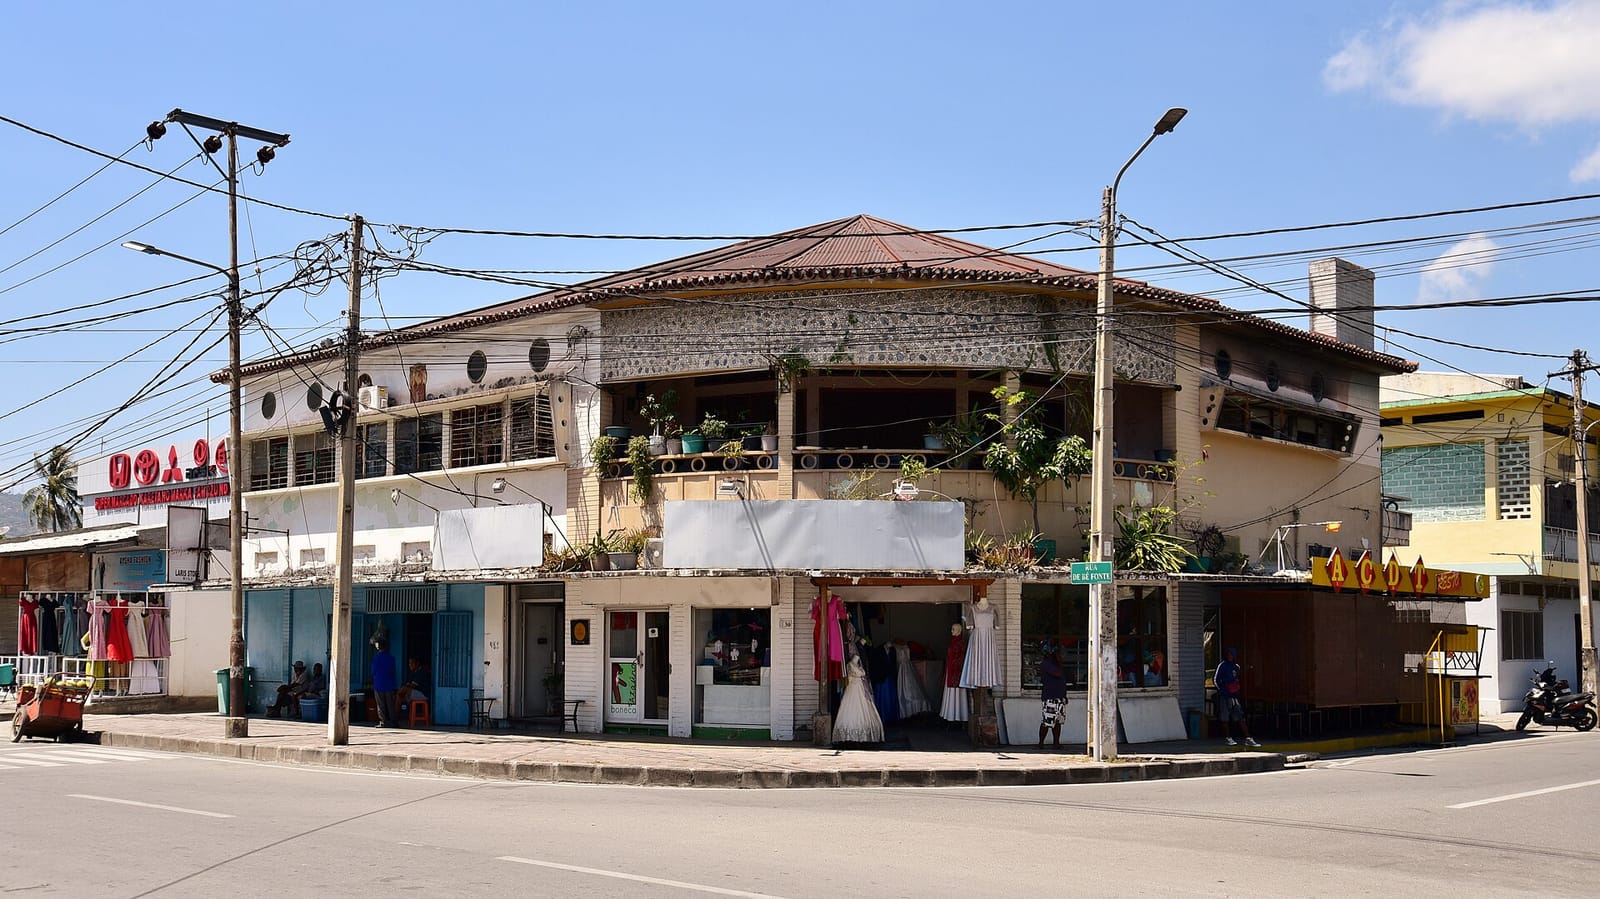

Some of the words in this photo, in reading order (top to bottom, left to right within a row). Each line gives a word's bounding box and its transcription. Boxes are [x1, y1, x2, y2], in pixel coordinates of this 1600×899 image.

[1085, 563, 1098, 571] RUA
[175, 569, 187, 577] LARIS
[1072, 573, 1081, 581] DE
[1090, 572, 1111, 581] FONTE
[610, 705, 637, 714] boneca
